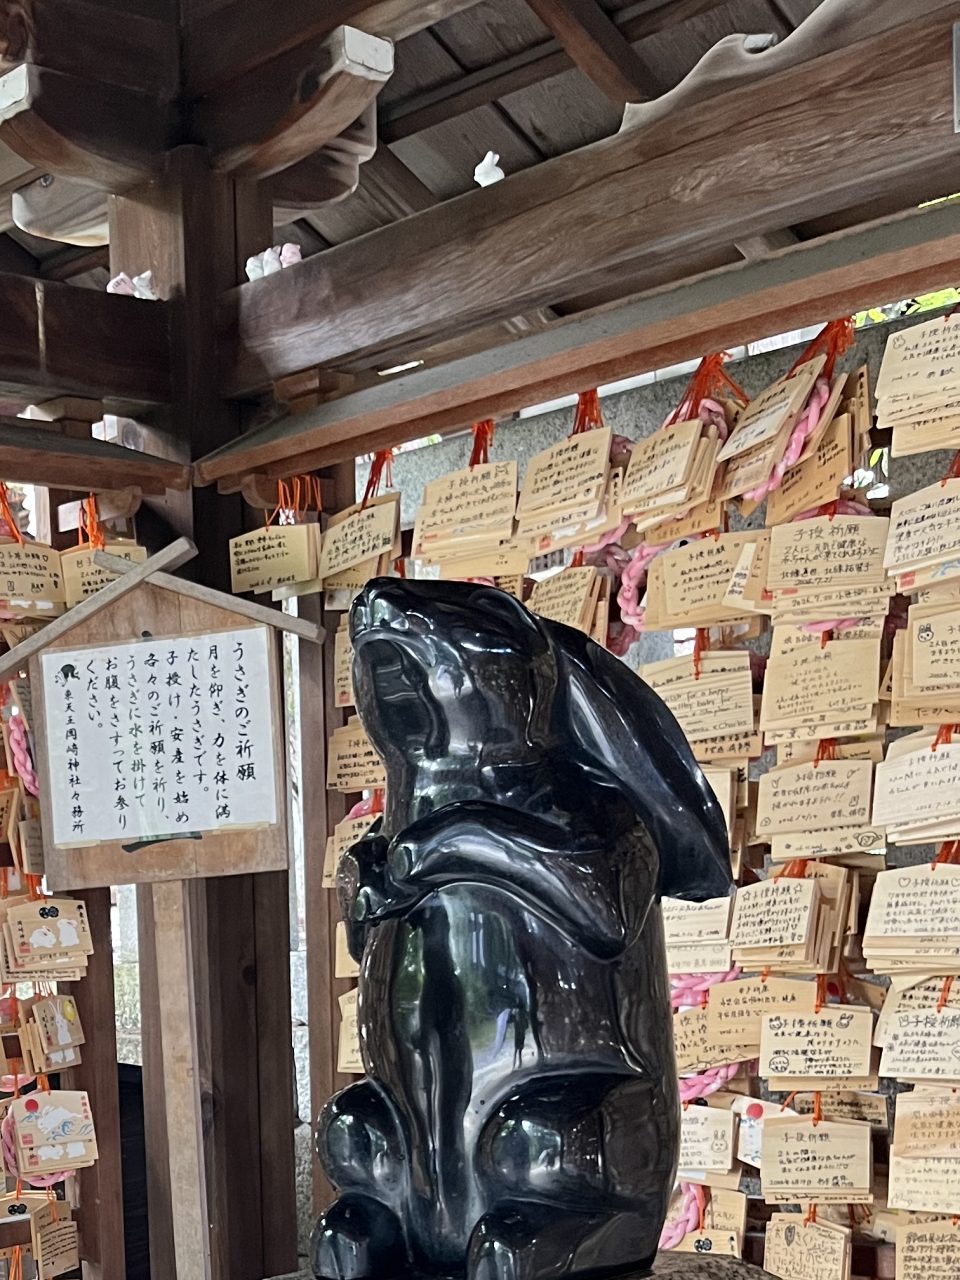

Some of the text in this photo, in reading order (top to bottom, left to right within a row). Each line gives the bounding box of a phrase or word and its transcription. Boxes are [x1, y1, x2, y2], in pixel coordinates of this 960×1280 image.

[794, 523, 860, 541] 子授祈願
[64, 690, 84, 833] 東天王岡崎神社々務所
[85, 659, 103, 728] ください。
[104, 657, 129, 830] お腹をさすってお参り
[125, 656, 146, 807] うさぎに水を掛けて
[144, 653, 170, 820] 各々のご祈願を祈り、
[166, 651, 189, 824] 子授け・安産を始め
[187, 648, 209, 793] たしたうさぎです。
[207, 644, 231, 819] 月を仰ぎ、力を体に満
[233, 642, 257, 781] うさぎのご祈願
